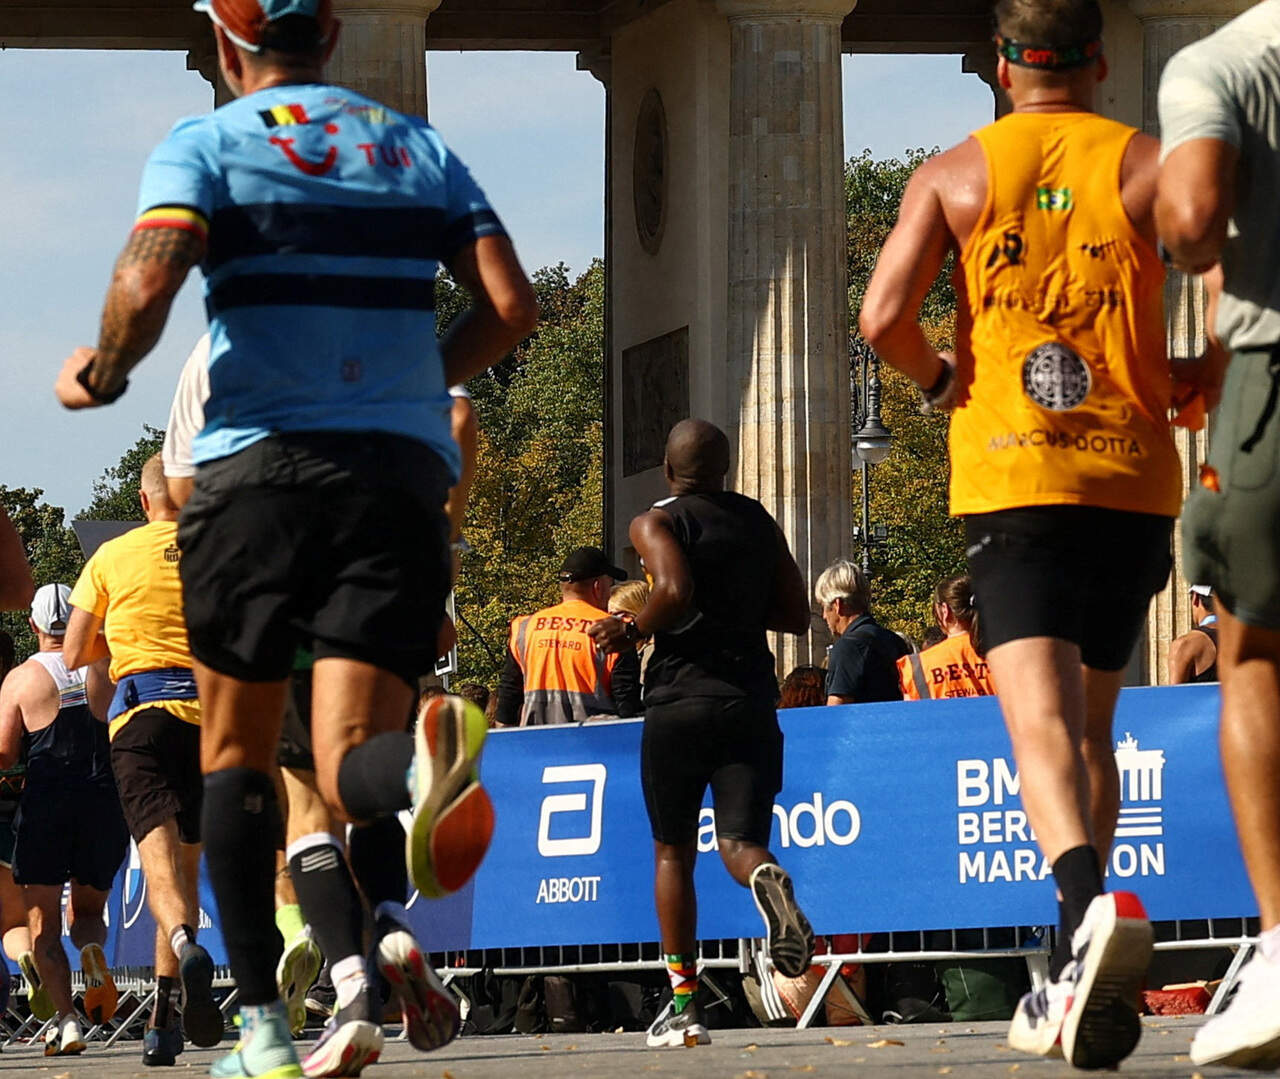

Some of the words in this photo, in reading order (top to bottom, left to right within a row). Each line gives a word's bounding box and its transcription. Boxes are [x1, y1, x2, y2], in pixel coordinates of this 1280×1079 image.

[357, 142, 412, 169] TUI
[956, 757, 1021, 807] BM
[957, 810, 1037, 845] BER
[958, 842, 1166, 884] MARAON
[535, 875, 601, 904] ABBOTT
